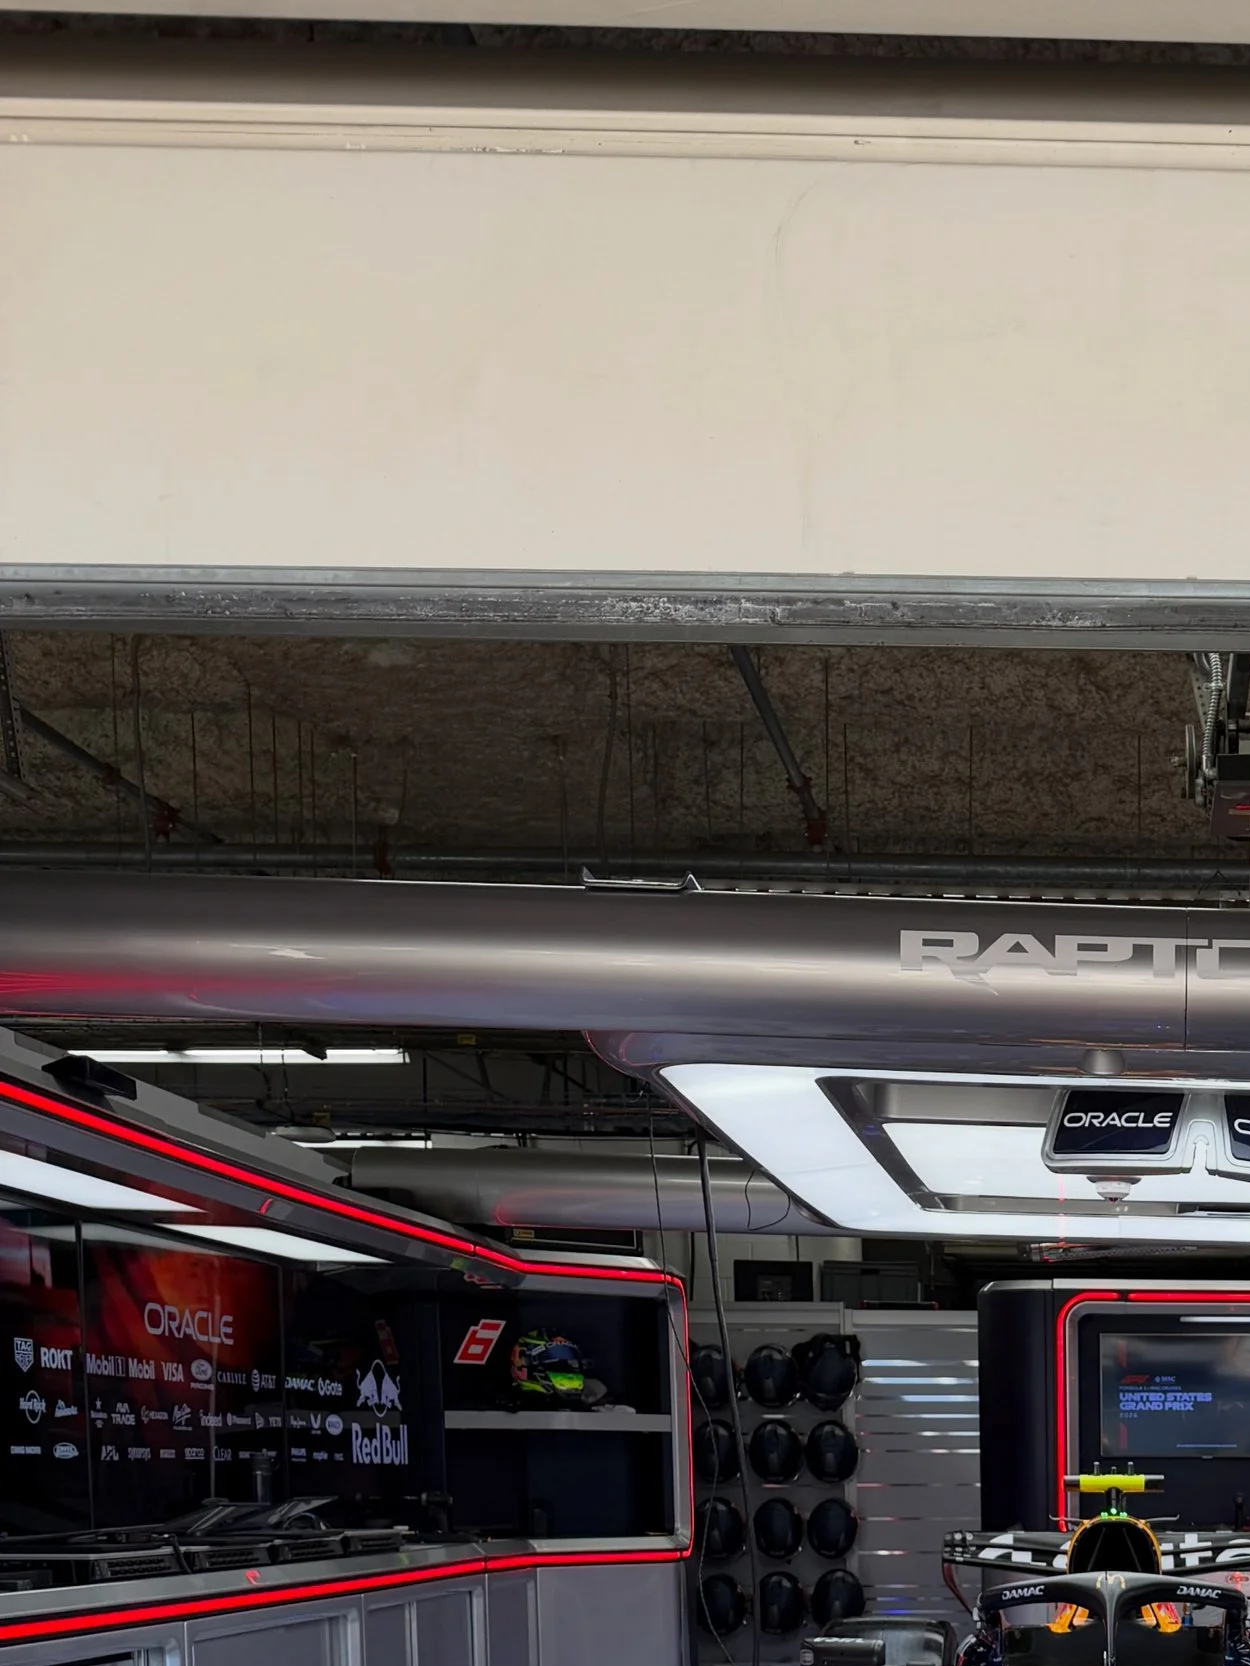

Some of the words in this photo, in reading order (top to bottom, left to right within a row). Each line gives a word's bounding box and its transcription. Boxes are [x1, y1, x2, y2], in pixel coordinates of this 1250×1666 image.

[1063, 1109, 1173, 1131] ORACLE
[143, 1302, 234, 1346] ORACLE
[40, 1346, 73, 1371] ROKT
[86, 1352, 115, 1377] Mobil
[128, 1356, 156, 1380] Mobil
[160, 1361, 185, 1383] VISA
[217, 1371, 247, 1385] CARLYLE
[260, 1374, 277, 1389] AT&T
[284, 1377, 316, 1391] DAMAC
[1119, 1392, 1165, 1402] UNITED
[1166, 1392, 1213, 1402] STATES
[1119, 1402, 1164, 1411] GRAND
[1165, 1402, 1194, 1411] PRIX
[111, 1414, 136, 1426] TRADE
[352, 1422, 381, 1465] Red
[382, 1424, 409, 1466] Bull
[1001, 1586, 1046, 1601] DAMAC
[1176, 1585, 1222, 1600] DAMAC
